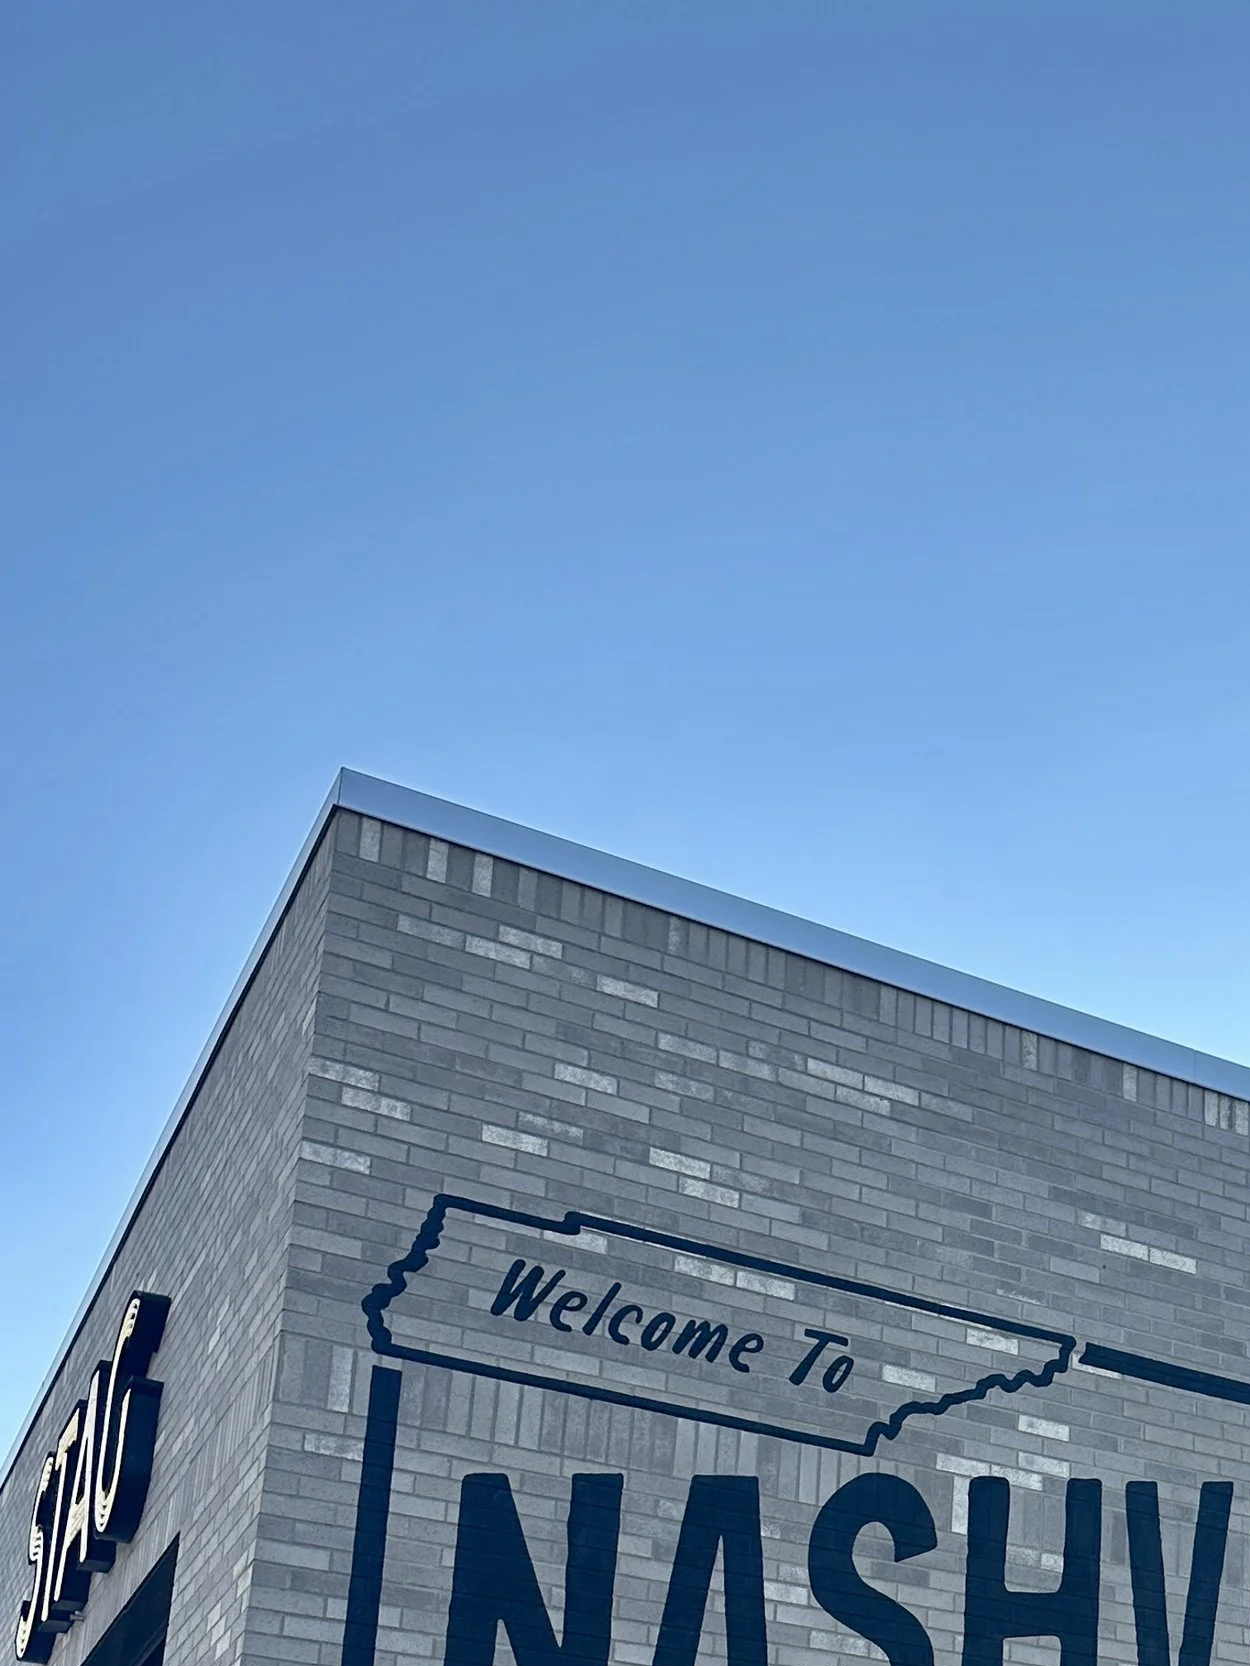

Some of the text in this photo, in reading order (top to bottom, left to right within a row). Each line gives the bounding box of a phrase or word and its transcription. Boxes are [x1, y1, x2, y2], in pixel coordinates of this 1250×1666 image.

[490, 1258, 856, 1394] Welcome To
[15, 1291, 168, 1663] STAG
